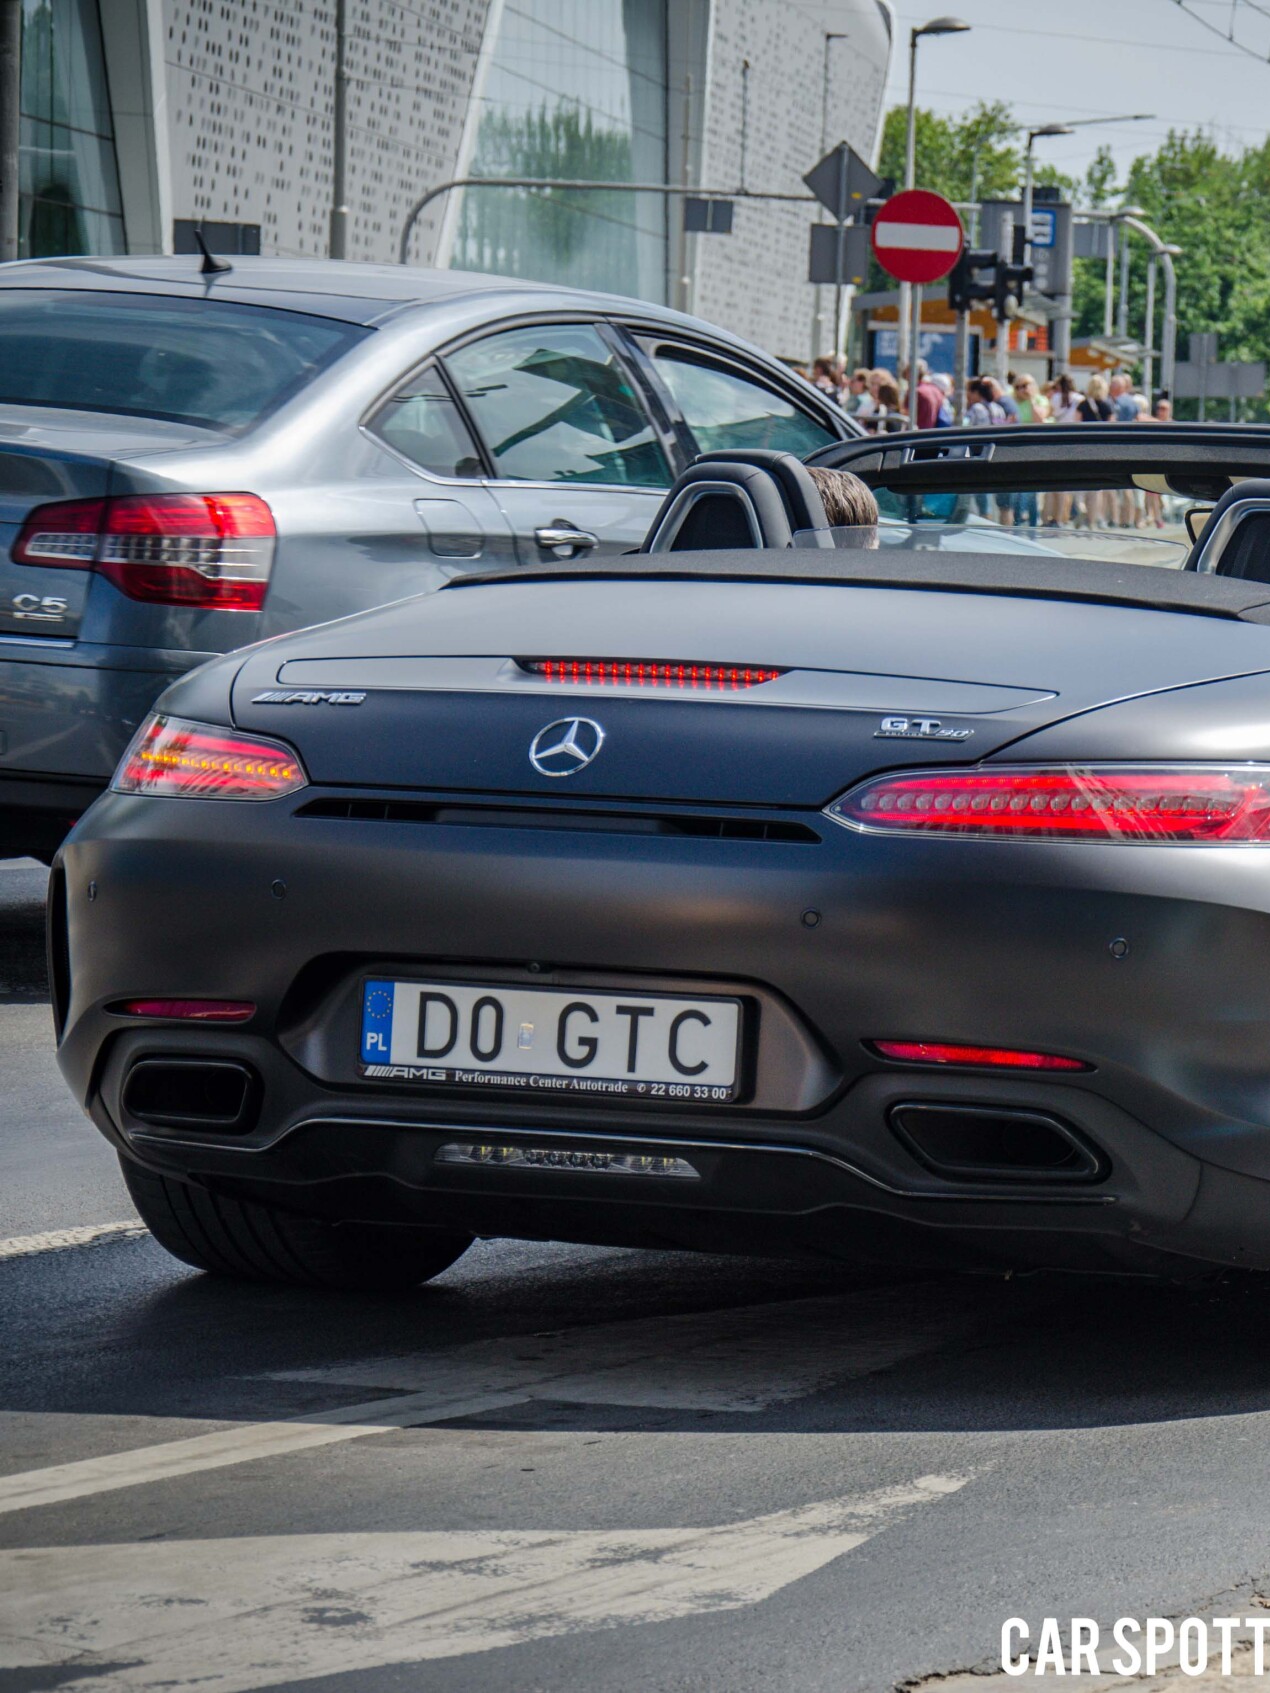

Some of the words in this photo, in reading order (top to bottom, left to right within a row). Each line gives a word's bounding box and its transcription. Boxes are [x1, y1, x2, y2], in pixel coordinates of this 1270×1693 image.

[12, 593, 68, 613] C5
[881, 717, 941, 735] GT
[365, 1032, 387, 1051] PL
[556, 1001, 712, 1077] GTC
[455, 1069, 527, 1087] Performance
[529, 1075, 568, 1089] Center
[570, 1077, 628, 1093] Autotrade
[650, 1083, 665, 1096] 22
[668, 1084, 690, 1098] 660
[693, 1086, 708, 1099] 33
[711, 1087, 726, 1100] 00
